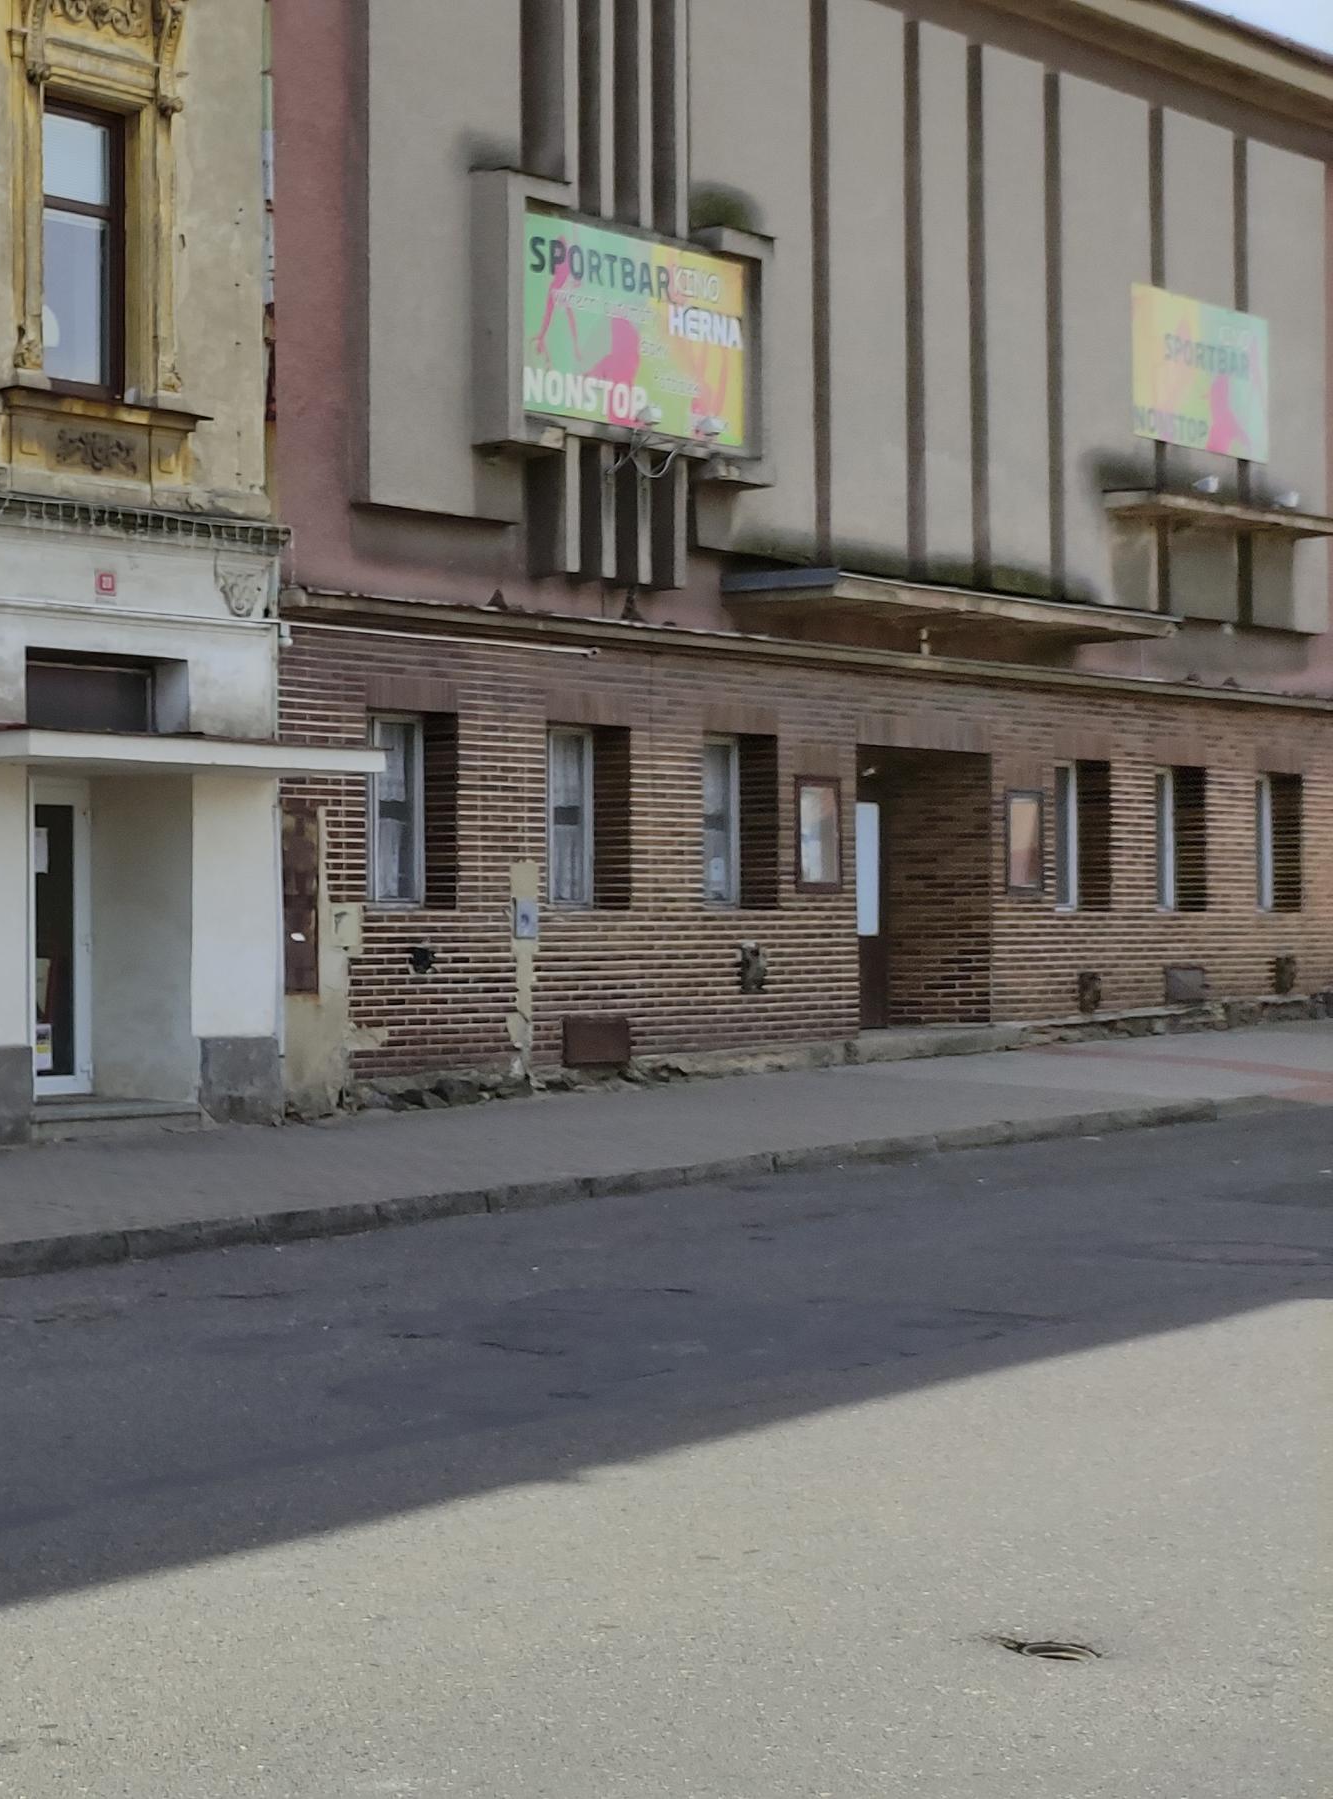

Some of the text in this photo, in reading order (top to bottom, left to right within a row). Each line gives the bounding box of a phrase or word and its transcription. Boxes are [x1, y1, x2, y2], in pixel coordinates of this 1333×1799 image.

[529, 236, 671, 302] SPORTBAR
[669, 304, 743, 349] HERNA
[524, 366, 650, 422] NONSTOP
